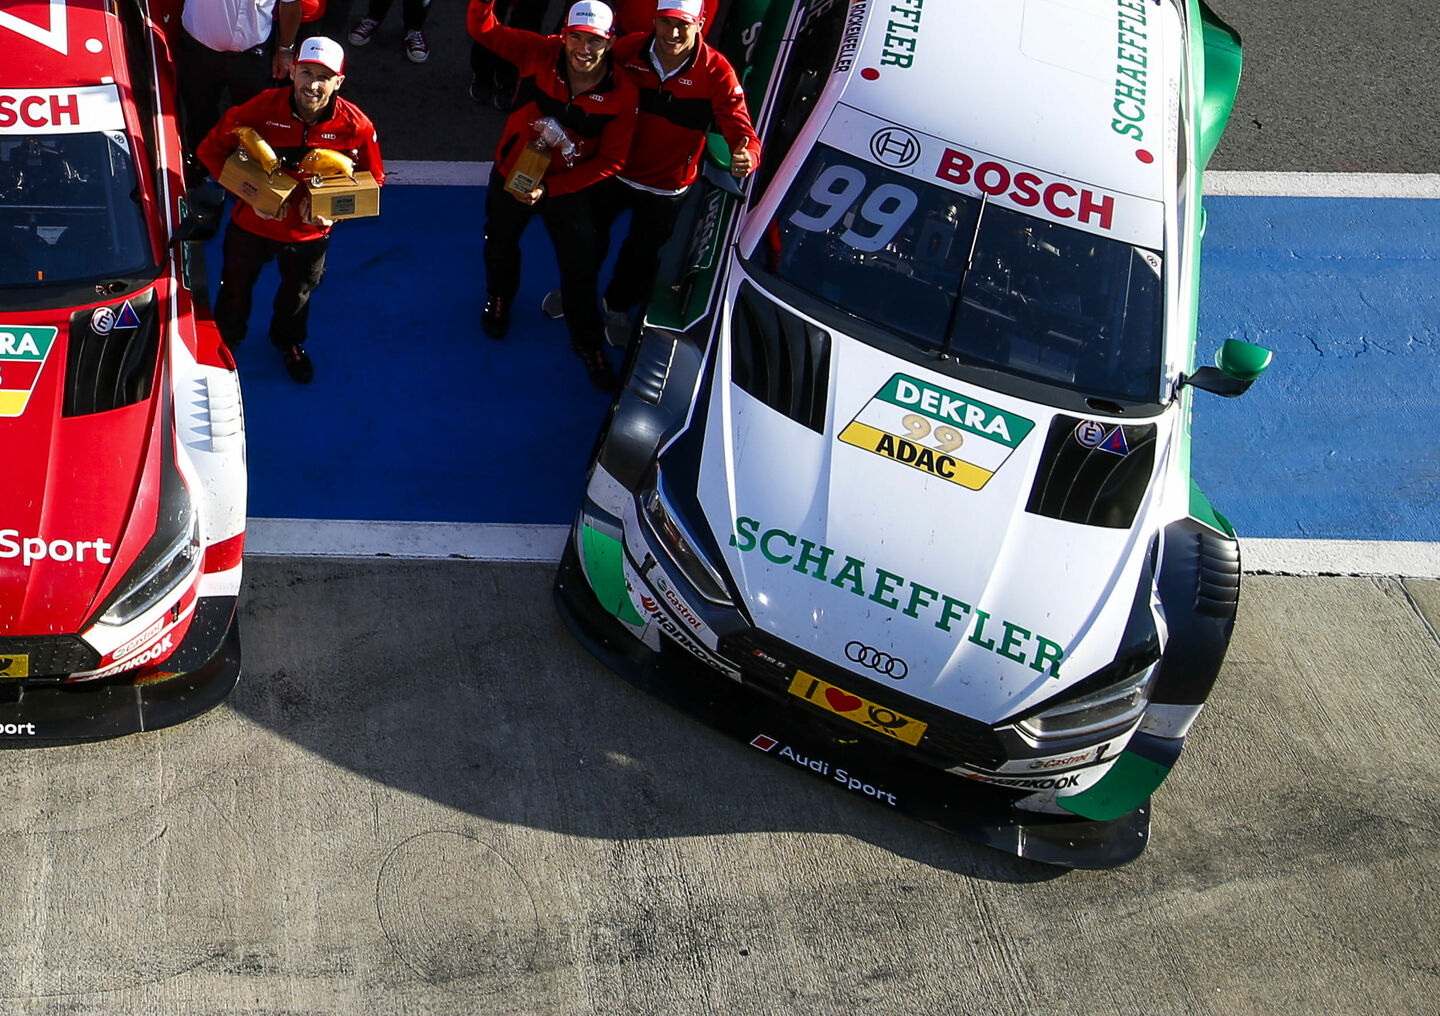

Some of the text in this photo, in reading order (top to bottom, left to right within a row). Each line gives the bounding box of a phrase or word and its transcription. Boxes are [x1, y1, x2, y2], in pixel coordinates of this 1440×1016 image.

[835, 3, 866, 74] ROCKENFELLER
[789, 164, 919, 253] 99
[935, 147, 1114, 231] BOSCH
[895, 379, 1011, 442] DEKRA
[902, 414, 964, 452] 99
[875, 434, 957, 479] ADAC
[665, 589, 702, 630] Castrol
[729, 516, 1063, 679] SCHAEFFLER
[779, 746, 897, 806] Audi Sport
[1044, 753, 1092, 768] Castrol
